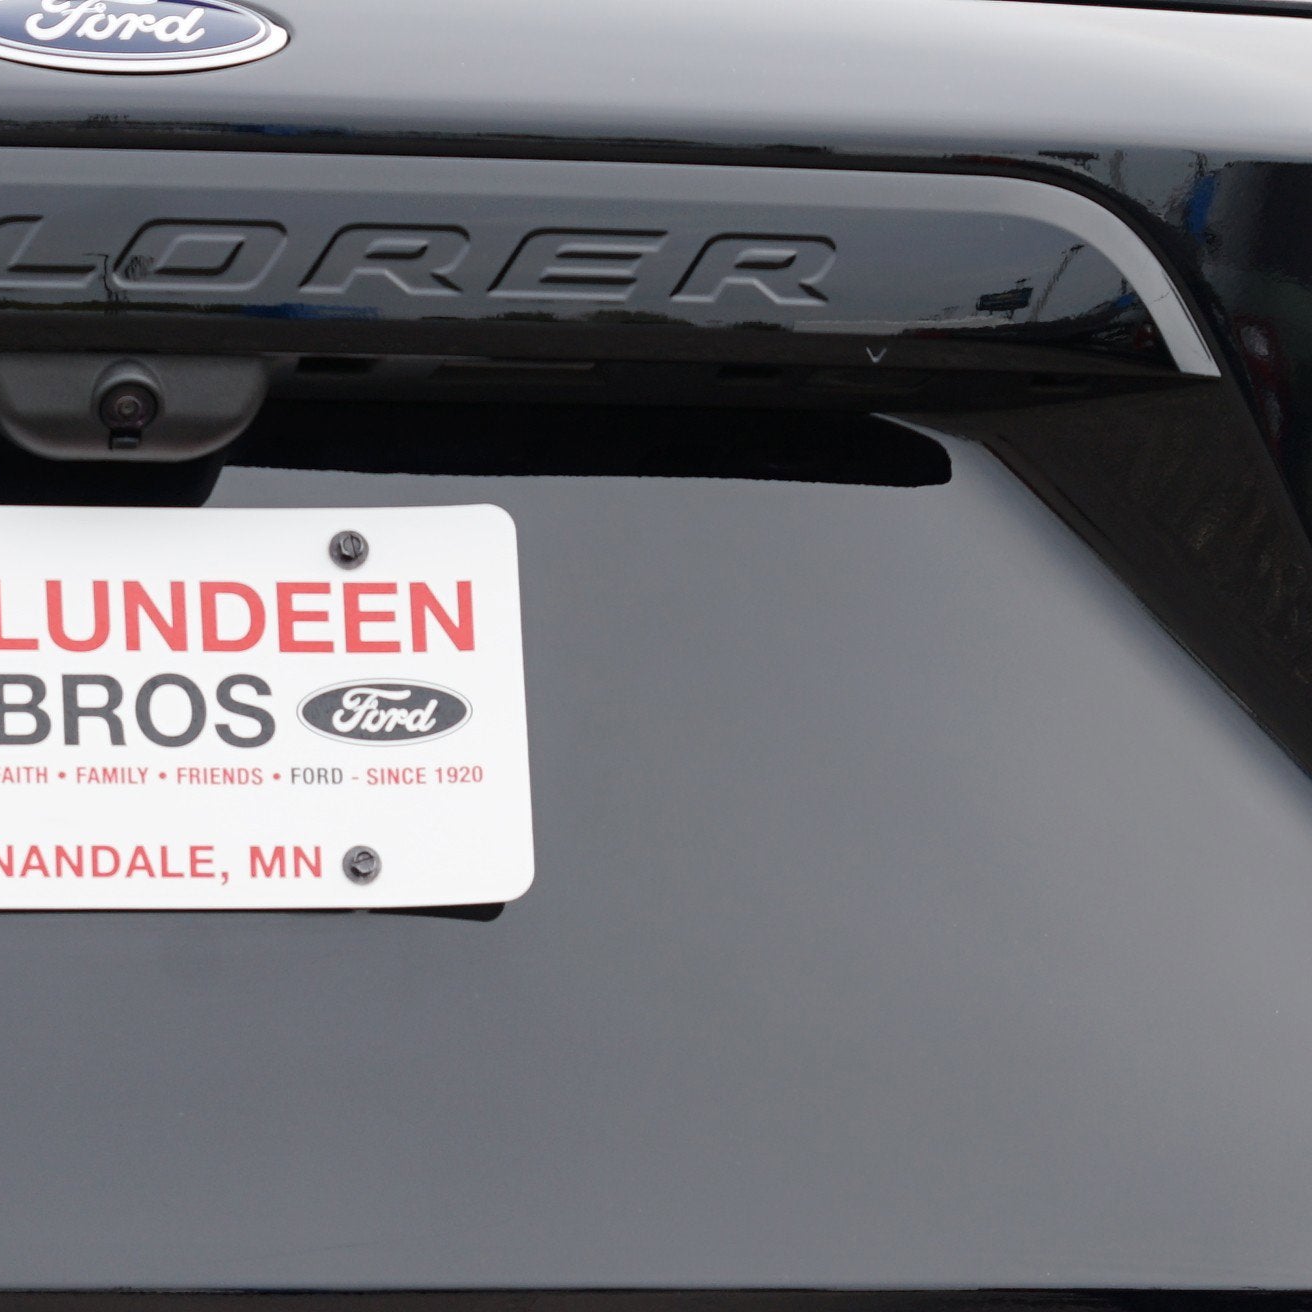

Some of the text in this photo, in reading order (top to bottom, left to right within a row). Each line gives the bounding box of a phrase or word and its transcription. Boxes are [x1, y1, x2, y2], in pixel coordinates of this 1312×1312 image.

[25, 0, 205, 43] Ford
[332, 687, 438, 733] Ford
[76, 767, 149, 785] FAMILY
[177, 767, 263, 785] FRIENDS
[291, 767, 343, 785] FORD
[367, 767, 427, 785] SINCE
[435, 765, 484, 785] 1920
[249, 845, 323, 878] MN
